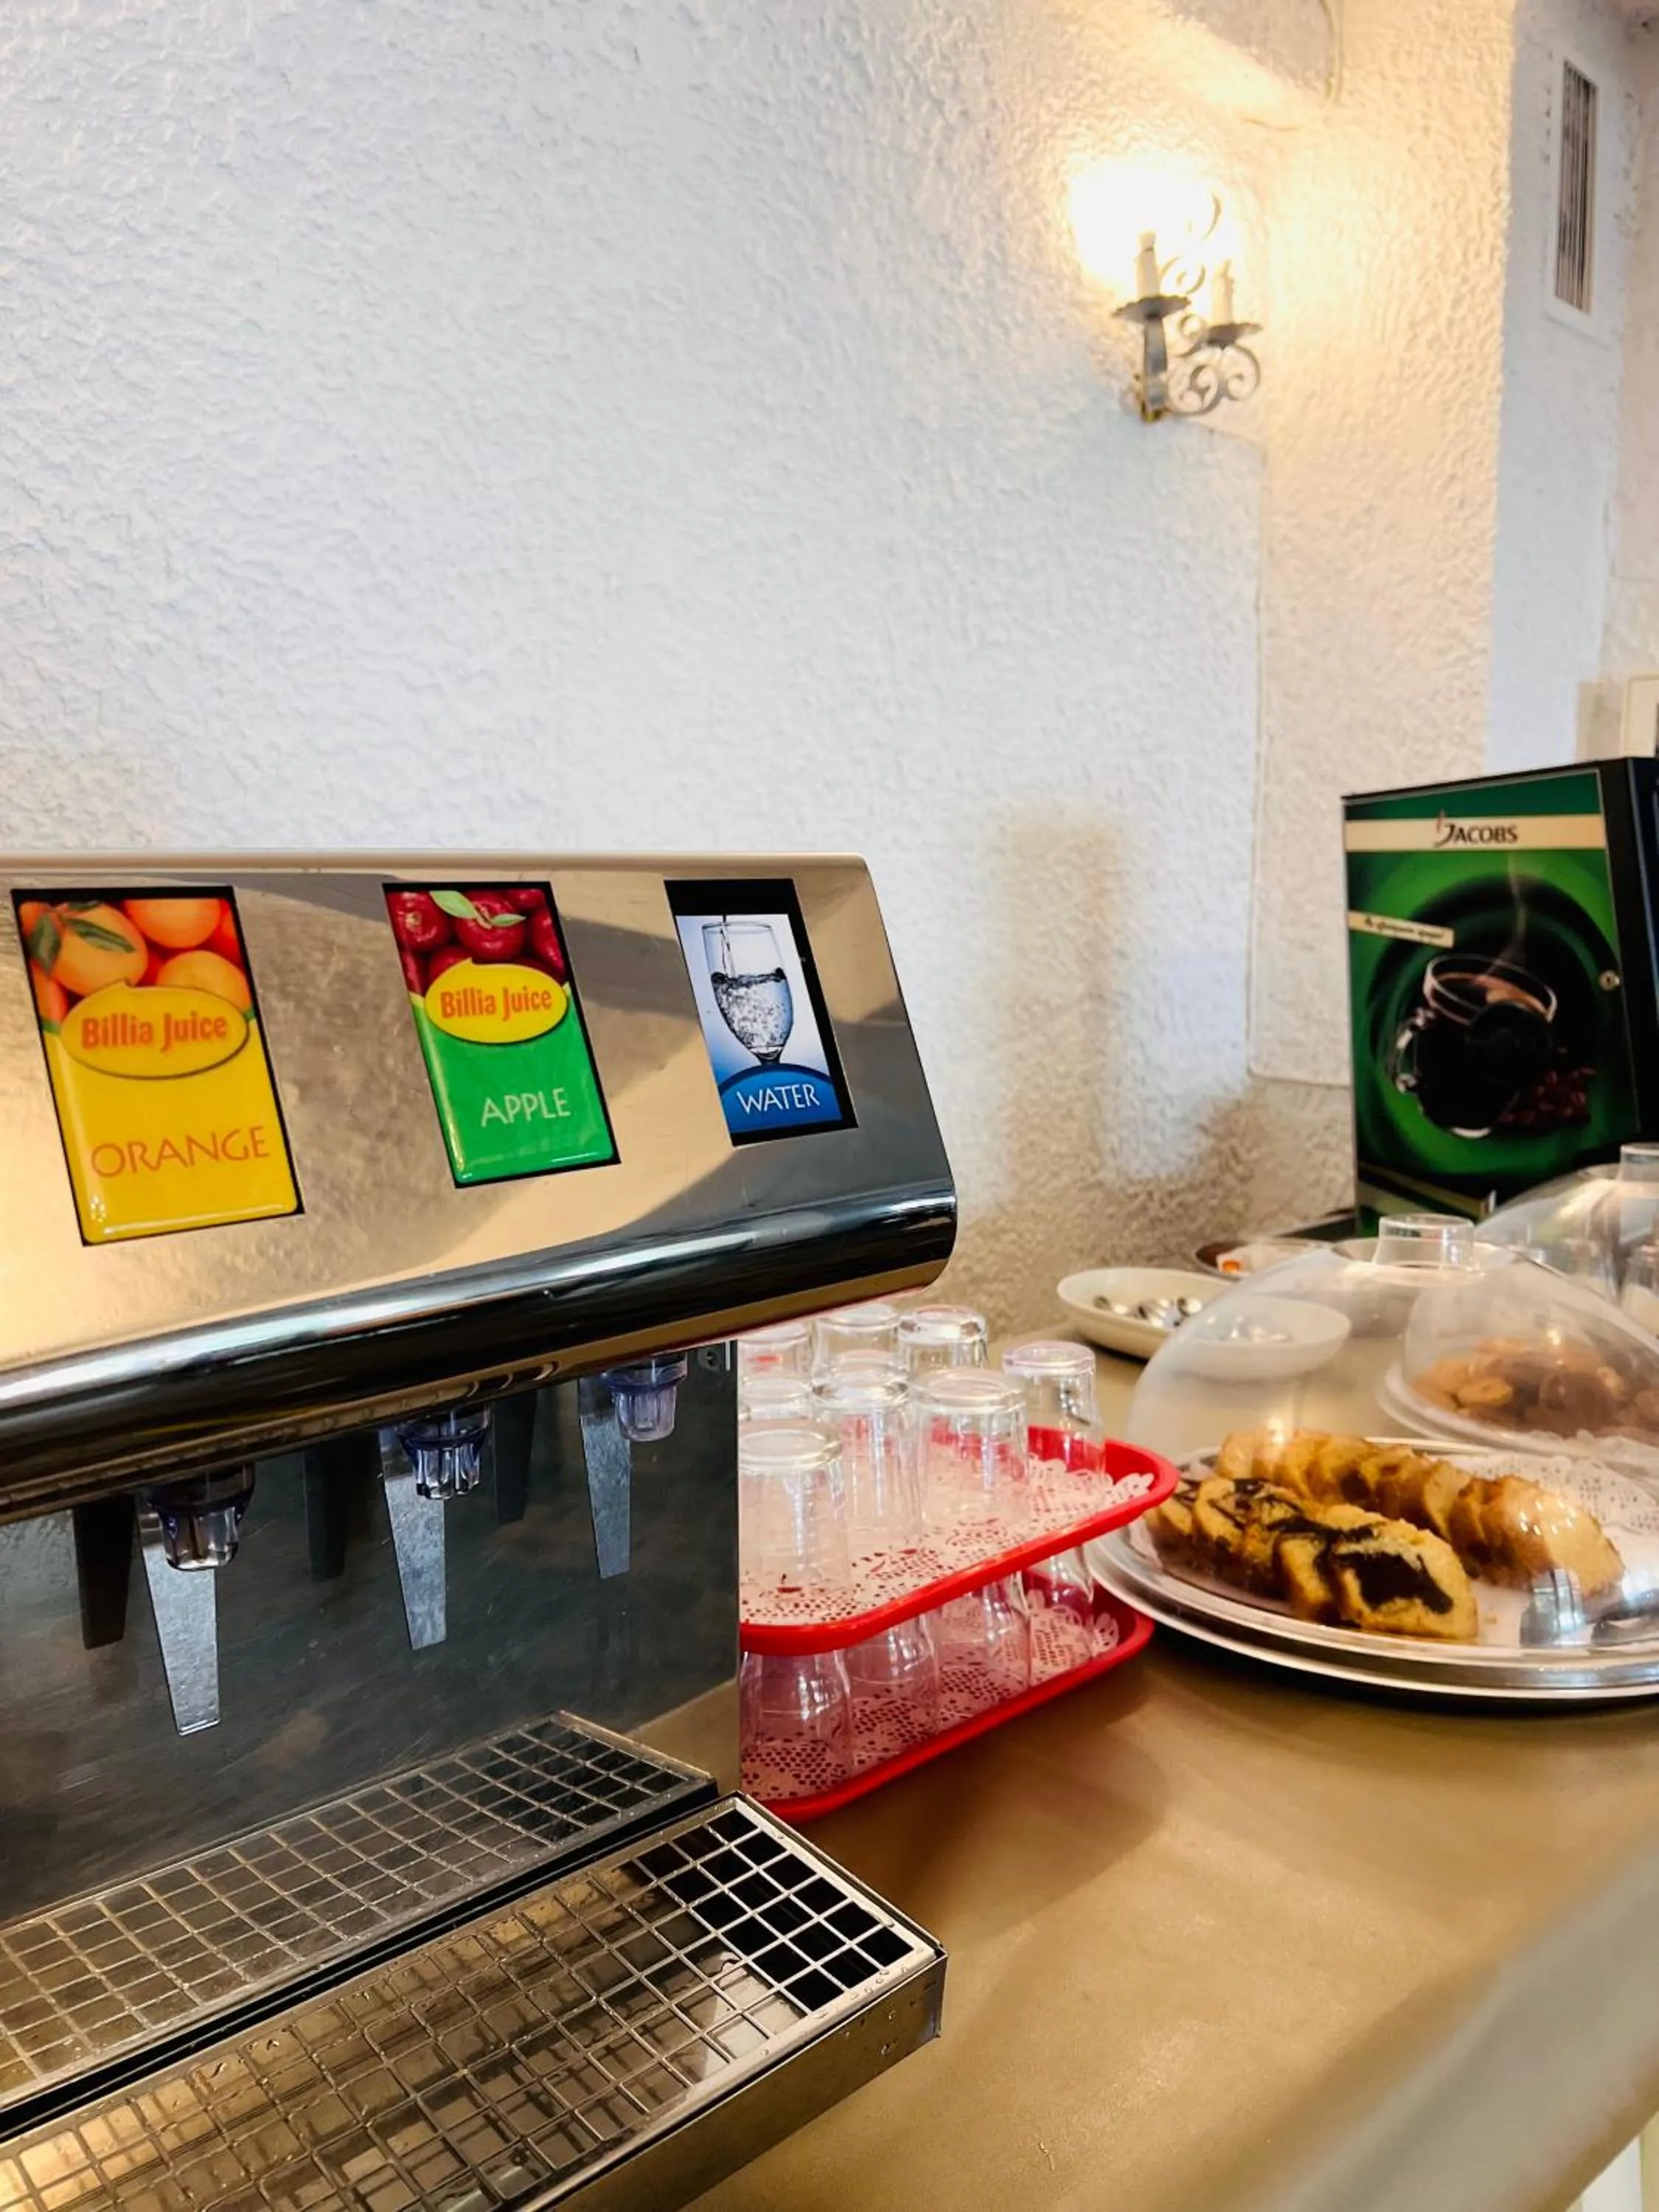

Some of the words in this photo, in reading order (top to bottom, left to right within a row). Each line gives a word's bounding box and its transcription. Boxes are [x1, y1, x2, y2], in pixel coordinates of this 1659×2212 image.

[1433, 823, 1519, 848] JACOBS
[442, 990, 496, 1019] Billia
[502, 986, 552, 1023] Juice
[80, 1013, 154, 1050] Billia
[160, 1010, 228, 1054] Juice
[480, 1088, 571, 1127] APPLE
[737, 1083, 820, 1115] WATER
[90, 1125, 270, 1178] ORANGE
